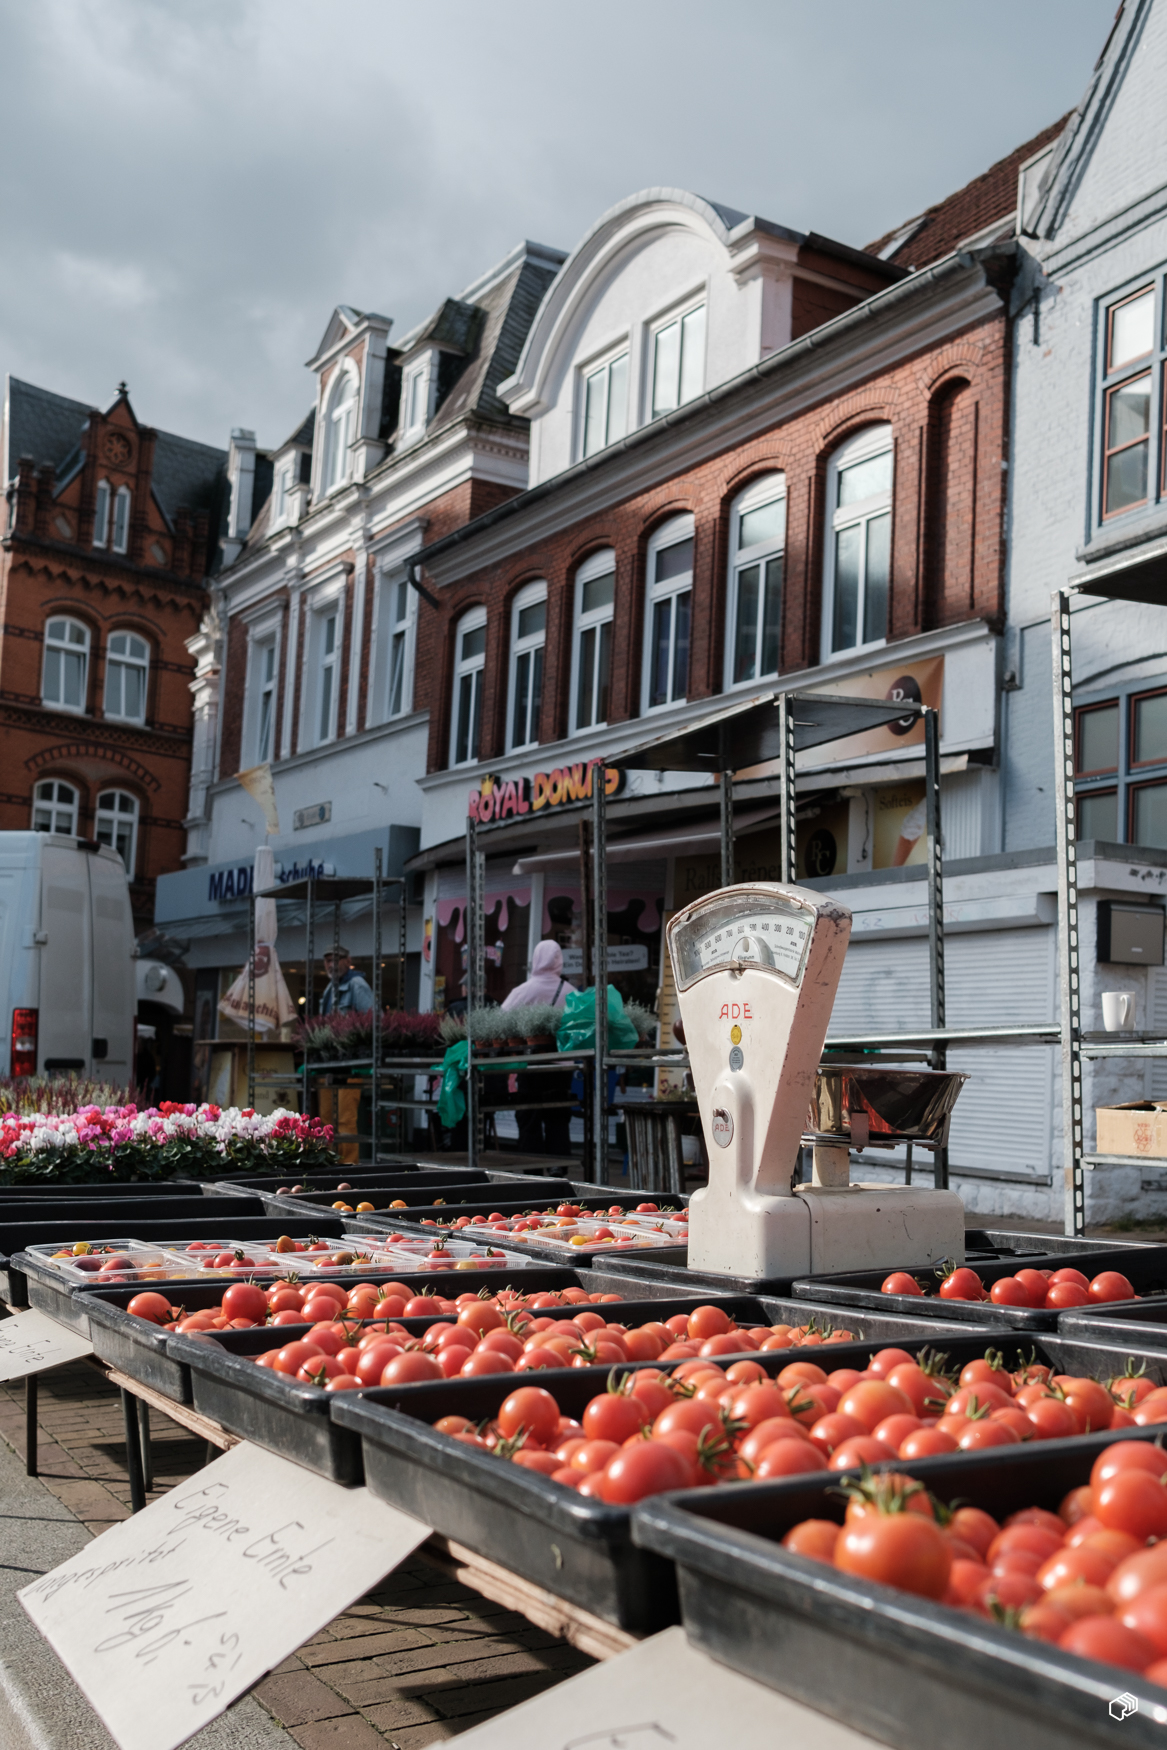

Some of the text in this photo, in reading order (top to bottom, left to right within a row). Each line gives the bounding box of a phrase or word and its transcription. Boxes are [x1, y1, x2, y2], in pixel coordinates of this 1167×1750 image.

[469, 777, 530, 823] ROYAL
[879, 795, 914, 811] Softeis
[725, 928, 733, 937] 700
[761, 923, 769, 931] 400
[773, 923, 782, 932] 300
[785, 926, 794, 935] 200
[719, 1003, 753, 1019] ADE
[714, 1123, 730, 1132] ADE
[167, 1482, 336, 1590] Eigene Ernte
[23, 1537, 188, 1603] ungespritzt
